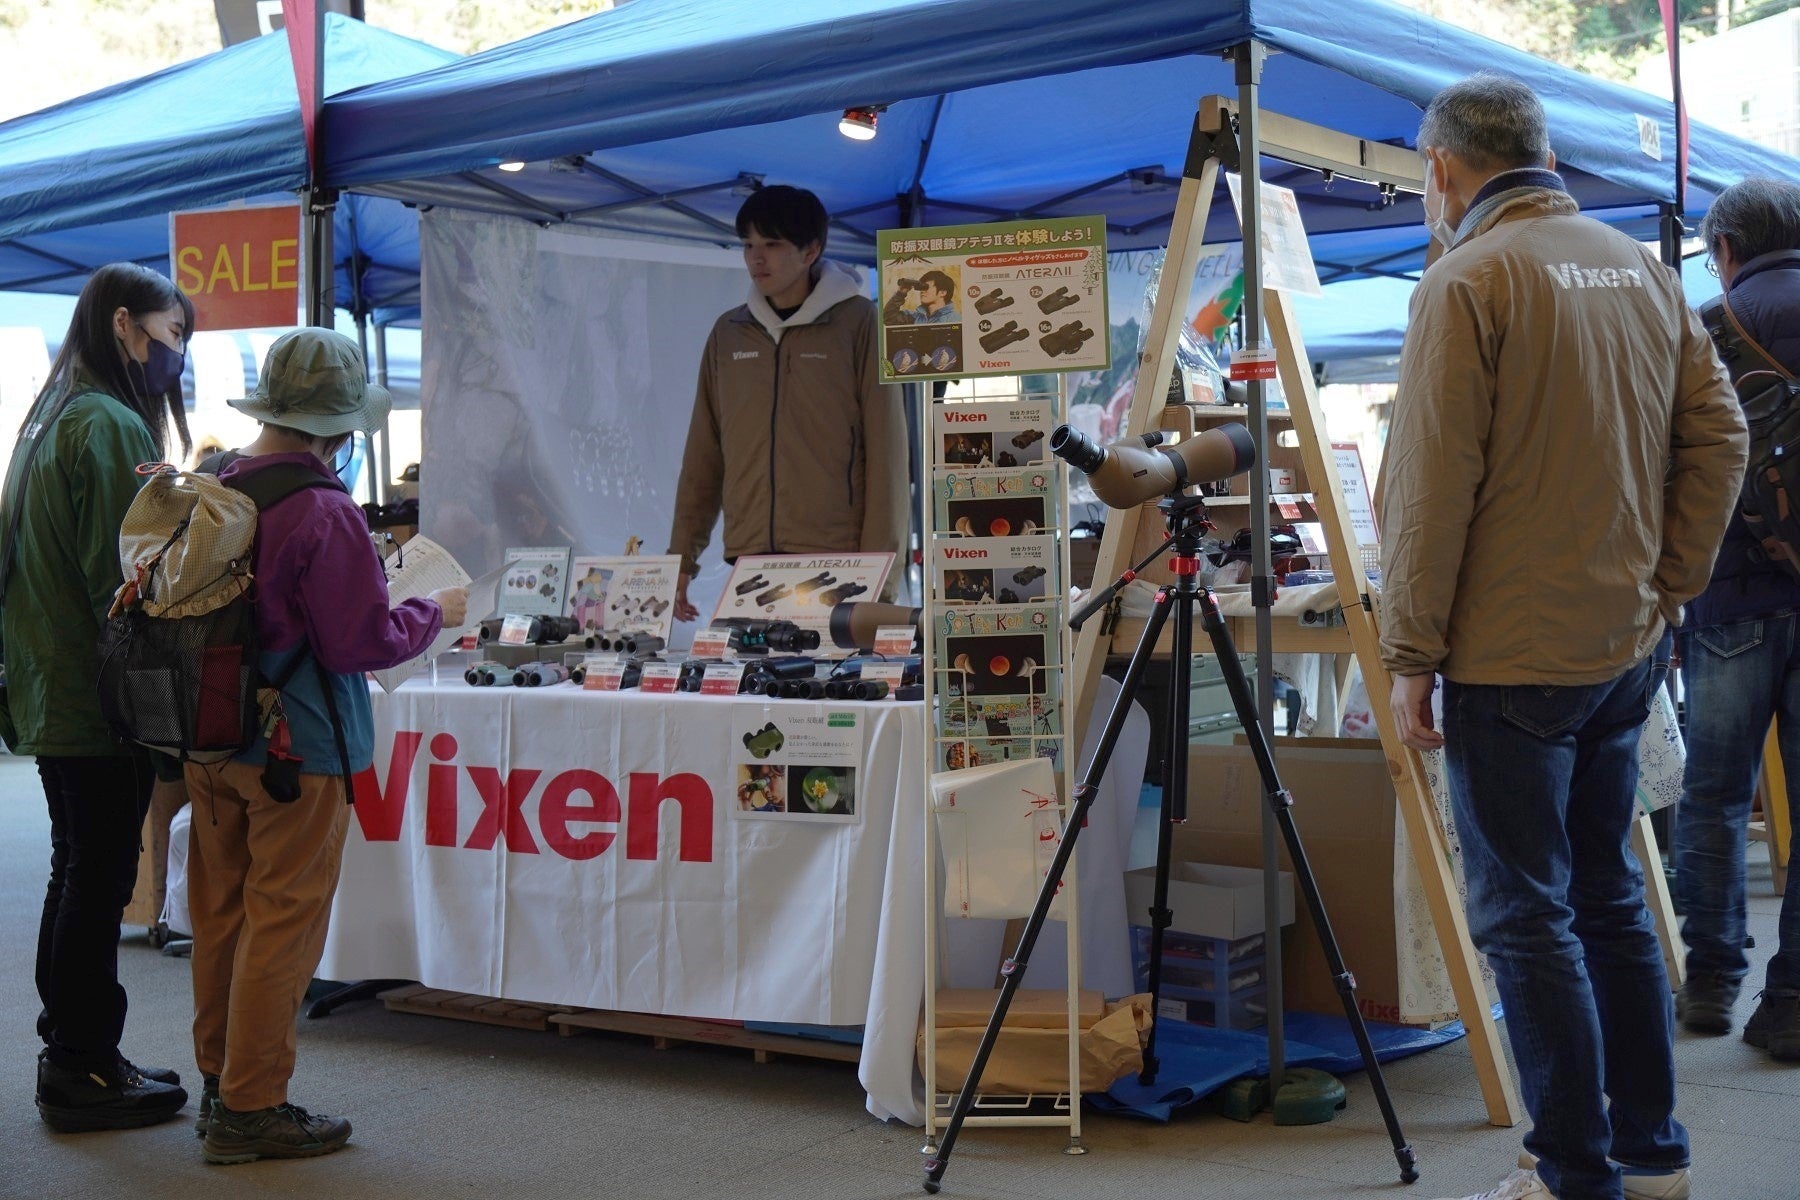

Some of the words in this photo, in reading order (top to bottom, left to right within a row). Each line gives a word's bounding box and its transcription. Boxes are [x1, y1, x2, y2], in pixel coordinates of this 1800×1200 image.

[177, 239, 298, 296] SALE
[1544, 262, 1643, 290] Vixen
[732, 350, 760, 360] Vixen
[978, 360, 1011, 369] Vixen
[943, 411, 988, 423] Vixen
[943, 547, 989, 559] Vixen
[352, 731, 714, 861] Vixen
